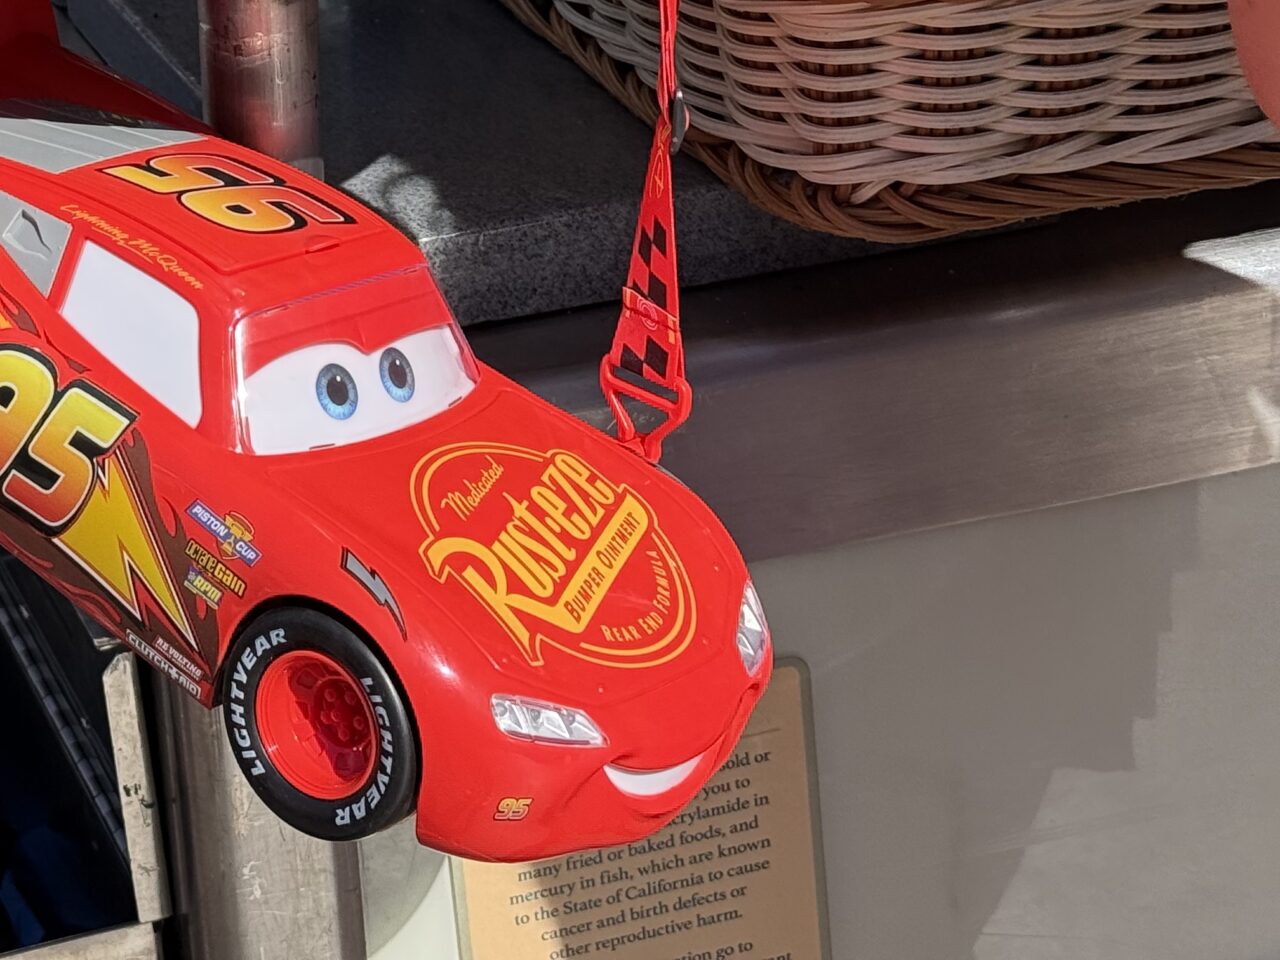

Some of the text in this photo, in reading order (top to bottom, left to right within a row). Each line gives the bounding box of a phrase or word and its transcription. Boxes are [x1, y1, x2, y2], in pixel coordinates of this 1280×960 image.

[94, 152, 357, 235] 95
[60, 203, 204, 291] Lightning McQueen
[441, 455, 505, 522] Medicated
[191, 504, 258, 561] PISTON CUP
[562, 511, 642, 625] BUMPER OINTMENT
[601, 549, 672, 643] REAR END FORMULA
[230, 627, 288, 777] LIGHTYEAR
[334, 676, 394, 828] LIGHTYEAR
[754, 749, 773, 764] or
[494, 797, 534, 821] 95
[702, 777, 751, 801] you to
[753, 793, 770, 807] in
[509, 837, 771, 907] mercury in fish, which are known
[517, 815, 760, 883] many fried or baked foods, and
[514, 859, 771, 927] to the State of California to cause
[541, 884, 748, 942] cancer and birth defects or
[549, 908, 743, 960] other reproductive harm.
[738, 938, 754, 953] to
